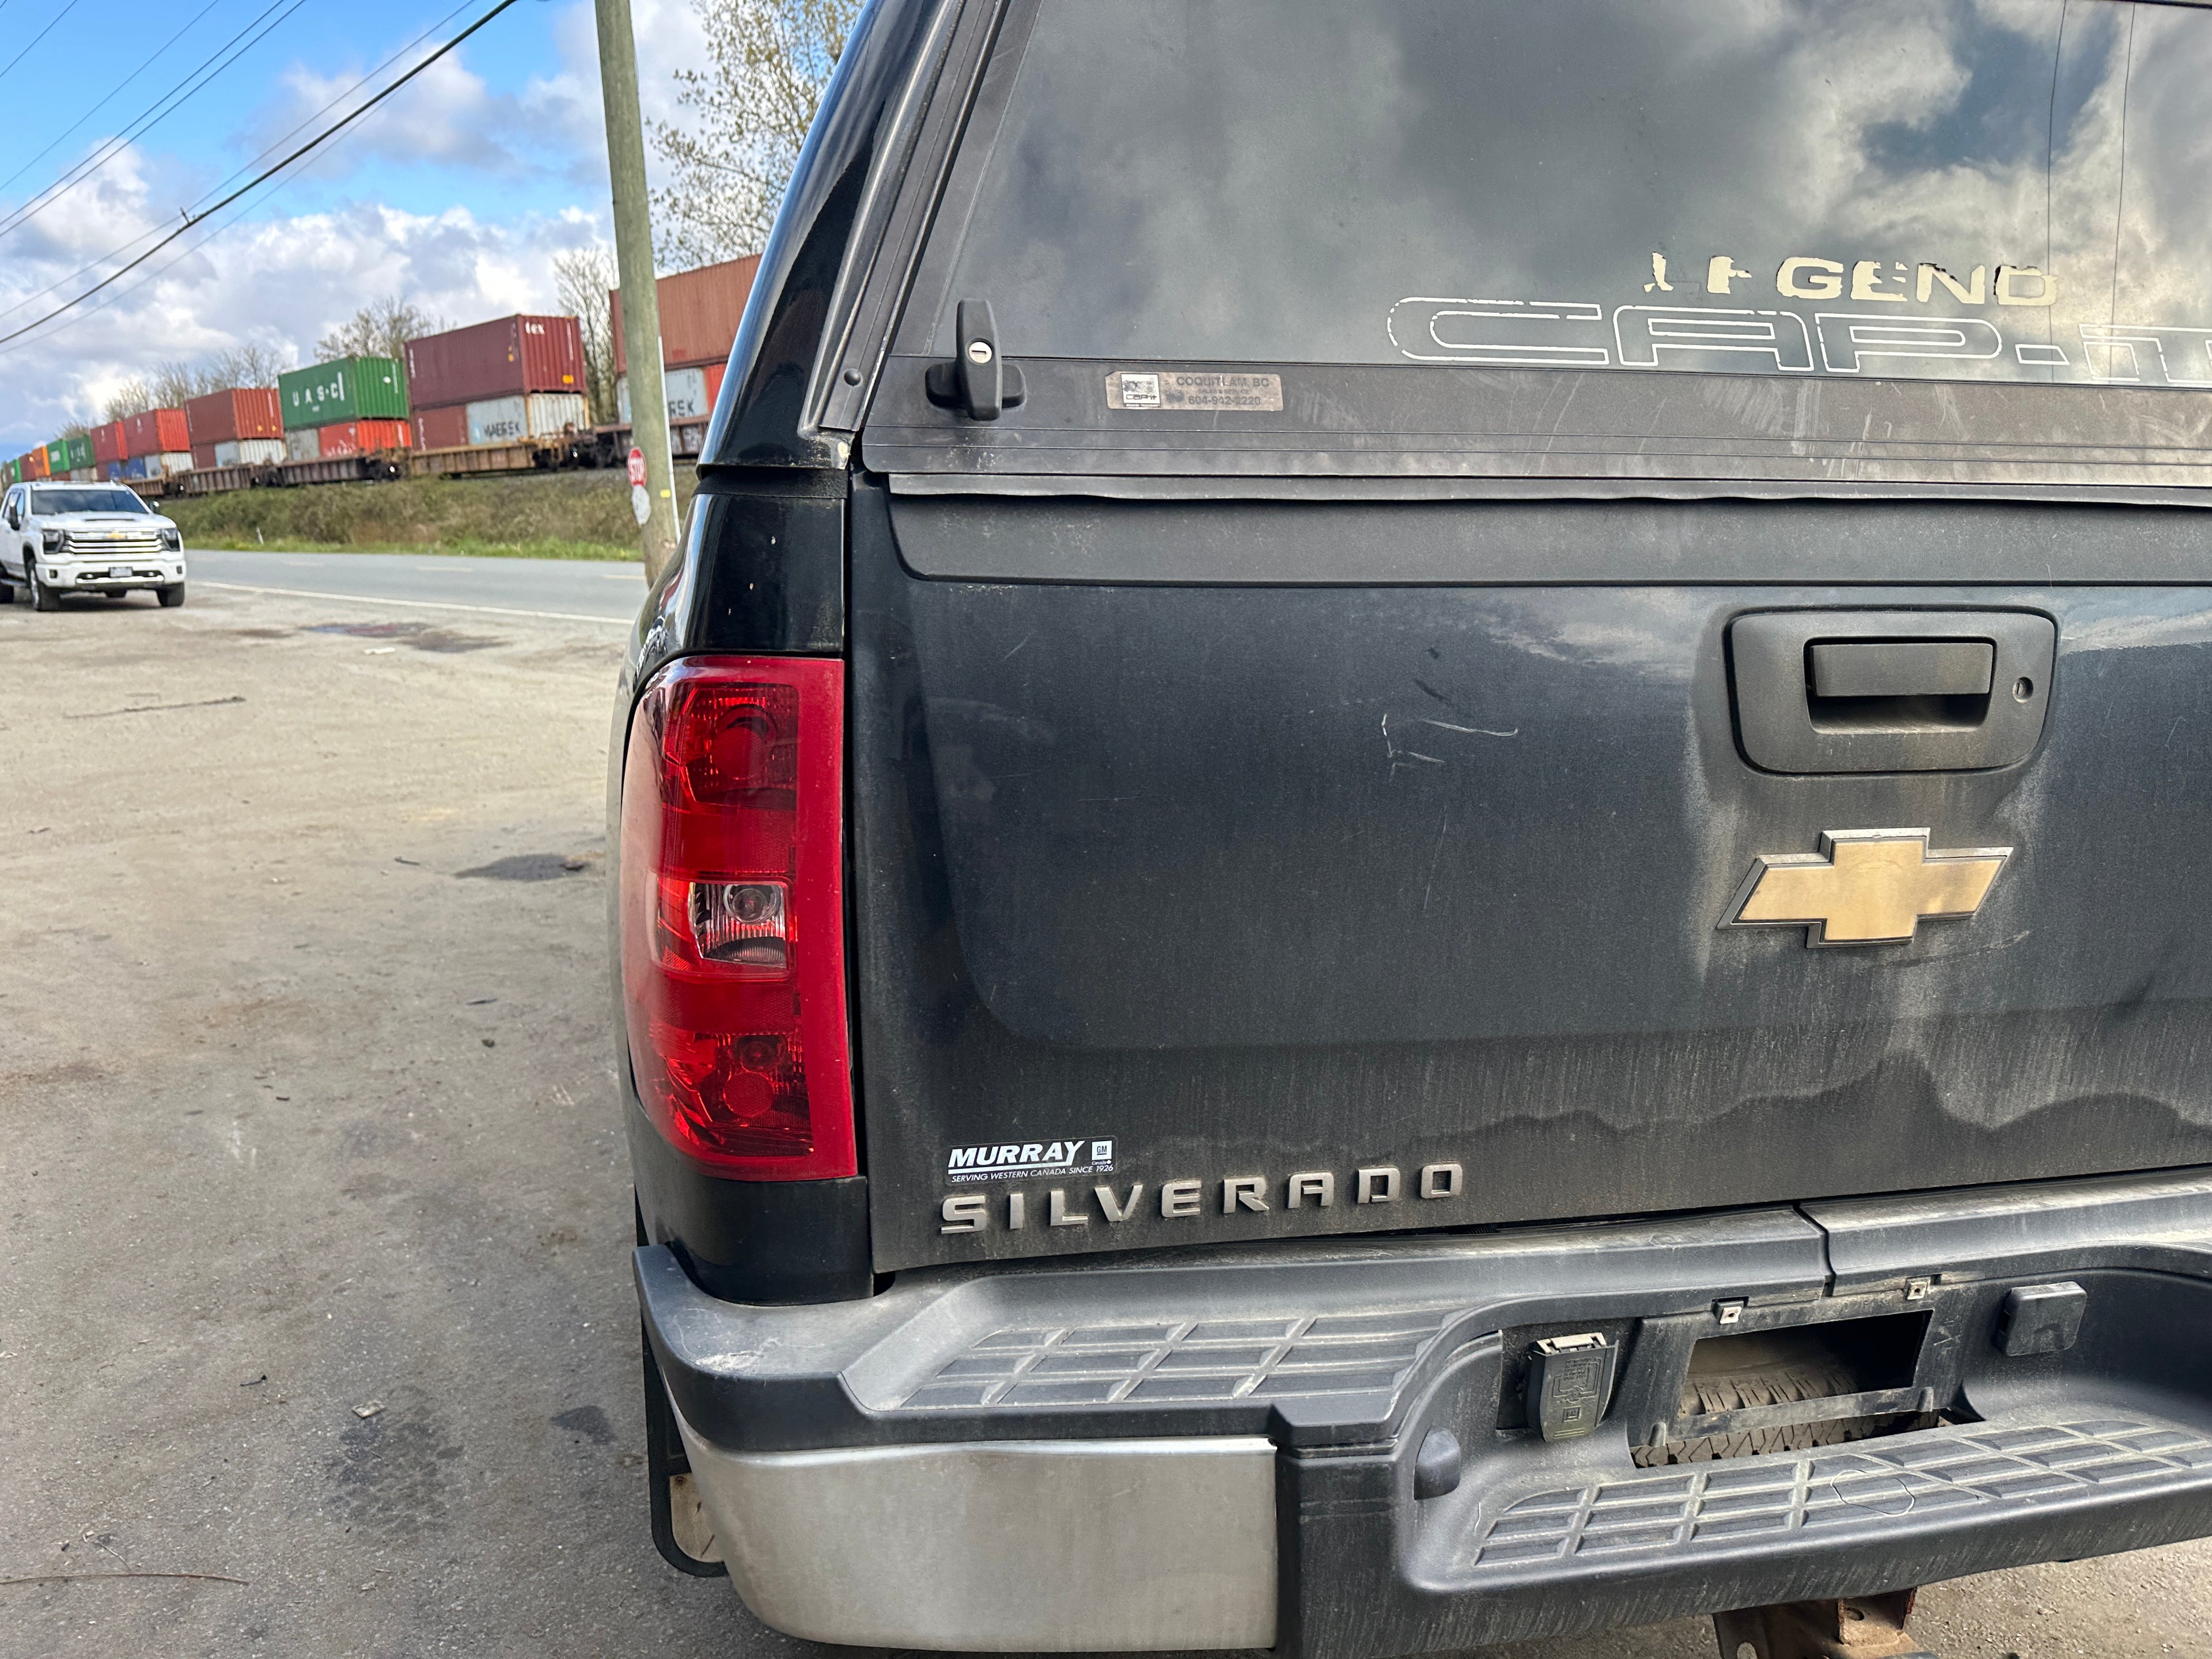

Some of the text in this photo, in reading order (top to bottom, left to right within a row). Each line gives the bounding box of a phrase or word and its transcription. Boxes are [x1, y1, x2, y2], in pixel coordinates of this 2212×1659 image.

[1252, 377, 1270, 387] BC
[629, 458, 645, 482] STOP
[948, 1140, 1107, 1167] MURRAY GM
[951, 1164, 1113, 1183] SERVING WESTERN CANADA SINCE 1926
[941, 1162, 1464, 1234] SILVERADO
